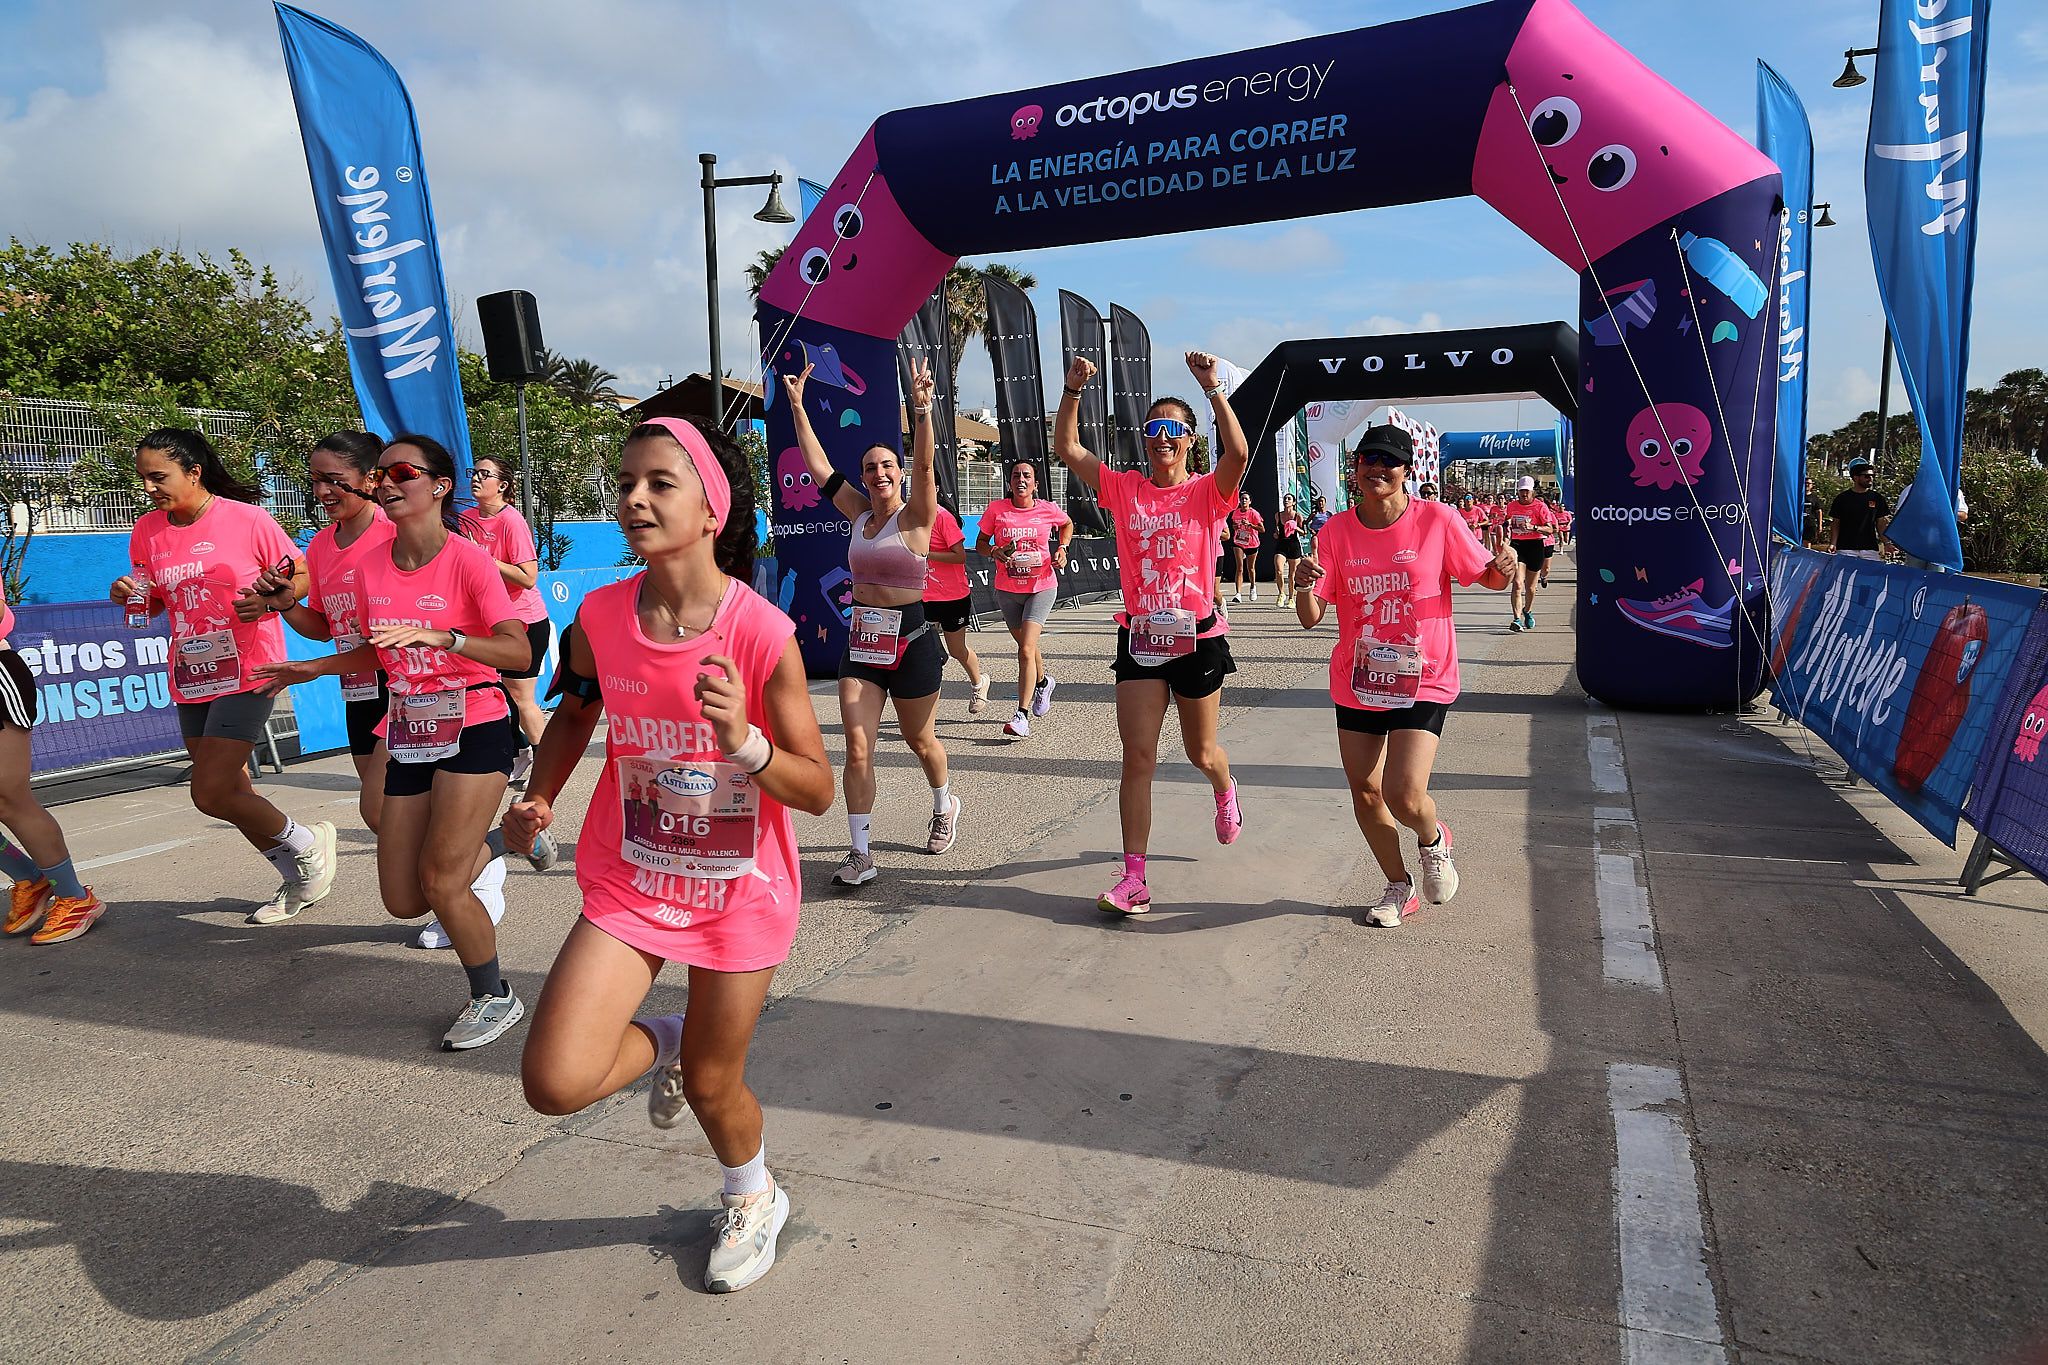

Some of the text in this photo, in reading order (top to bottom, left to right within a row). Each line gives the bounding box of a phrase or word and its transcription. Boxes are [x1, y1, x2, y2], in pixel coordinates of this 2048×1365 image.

[1055, 59, 1335, 126] octopus energy
[991, 113, 1349, 185] LA ENERGÍA PARA CORRER
[994, 147, 1357, 215] A LA VELOCIDAD DE LA LUZ
[1318, 348, 1514, 374] VOLVO
[1479, 432, 1531, 456] Marlene
[1129, 511, 1182, 530] CARRERA
[1591, 502, 1750, 526] octopus energy
[805, 520, 852, 536] energ
[154, 560, 205, 587] CARRERA
[1155, 571, 1171, 594] LA
[1347, 571, 1410, 594] CARRERA
[1380, 598, 1400, 625] DE
[183, 644, 212, 653] ASTURIANA
[860, 632, 879, 643] 016
[1150, 634, 1175, 646] 016
[189, 661, 218, 675] 016
[406, 646, 434, 675] DE
[604, 674, 648, 695] OYSHO
[1368, 671, 1397, 684] 016
[408, 719, 438, 734] 016
[610, 713, 720, 753] CARRER
[394, 751, 419, 759] OYSHO
[630, 762, 655, 774] SUMA
[661, 773, 713, 791] ASTURIANA
[659, 811, 711, 836] 016
[633, 834, 657, 849] CARRERA
[658, 844, 668, 852] DE
[668, 845, 677, 853] LA
[678, 847, 702, 856] MUJER
[707, 849, 740, 857] VALENCIA
[671, 835, 696, 846] 2369
[632, 848, 740, 872] OYSHO Santander
[631, 867, 728, 912] MUJER
[653, 902, 693, 928] 2026
